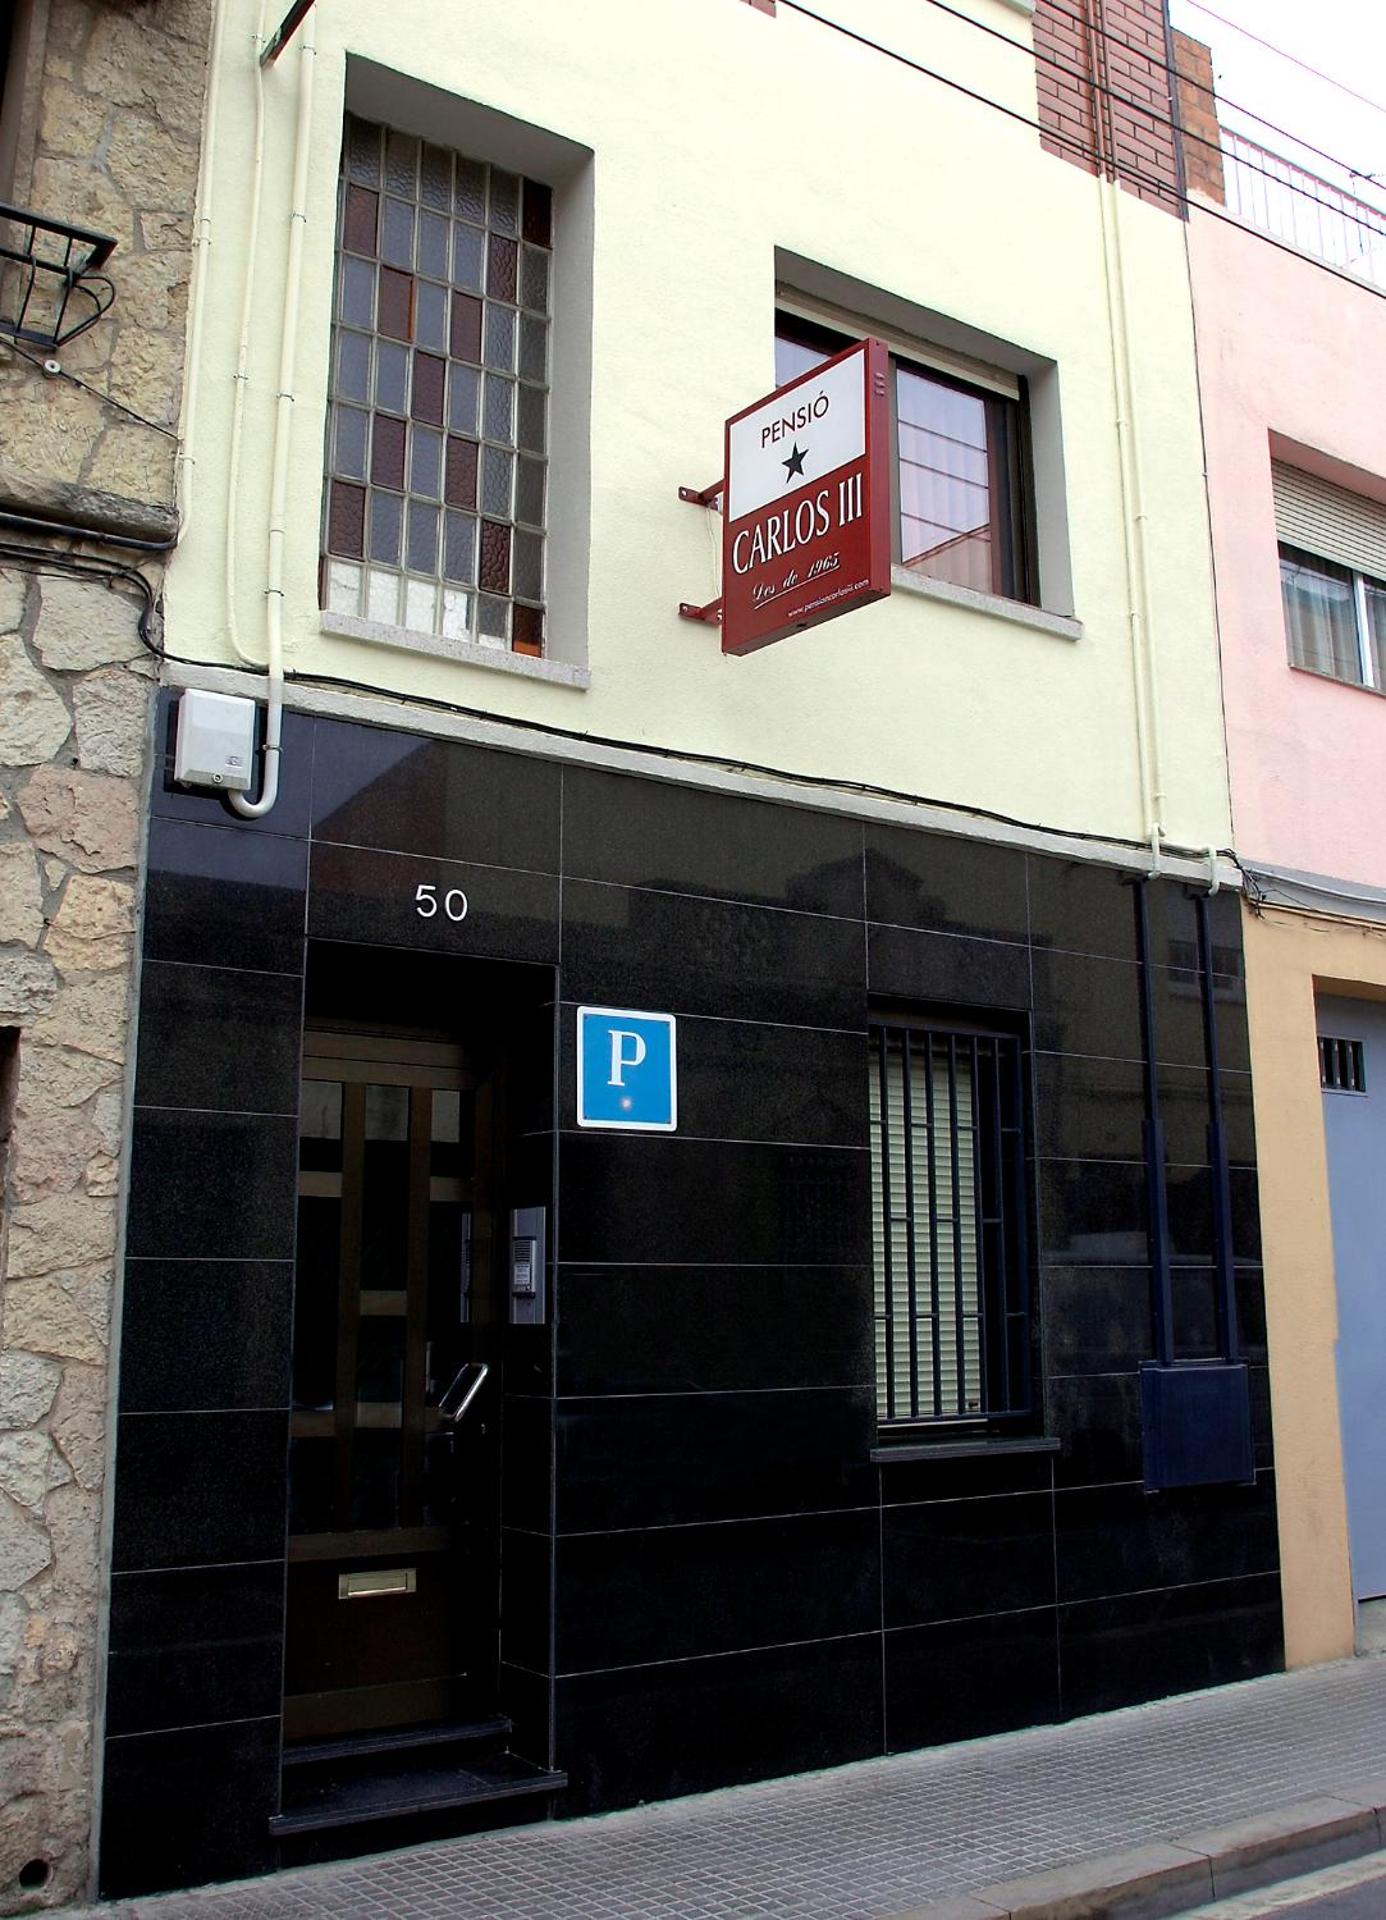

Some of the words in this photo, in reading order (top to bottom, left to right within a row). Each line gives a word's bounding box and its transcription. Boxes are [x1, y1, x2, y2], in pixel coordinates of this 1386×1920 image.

[761, 390, 829, 448] PENSIÓ
[732, 489, 830, 574] CARLOS
[838, 472, 862, 527] III
[782, 569, 799, 588] de
[806, 552, 840, 578] 1965
[415, 884, 468, 921] 50
[607, 1029, 646, 1086] P
